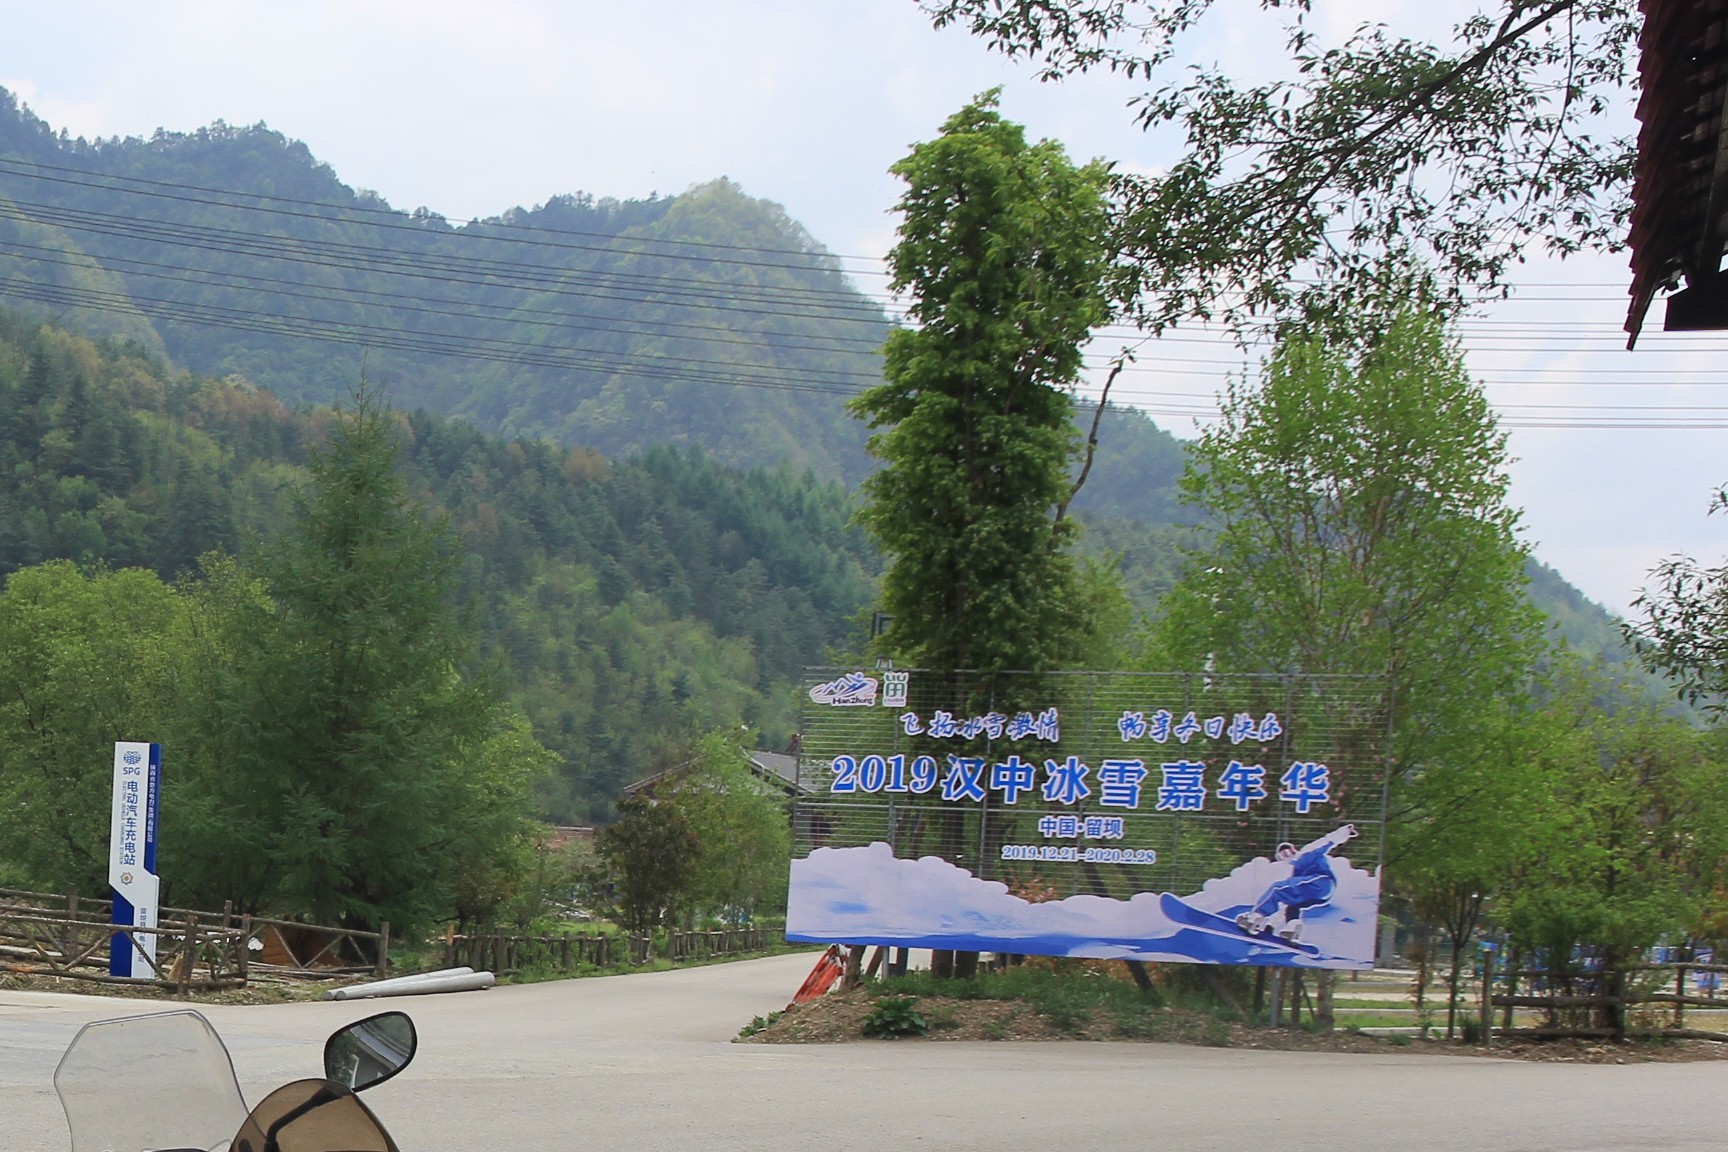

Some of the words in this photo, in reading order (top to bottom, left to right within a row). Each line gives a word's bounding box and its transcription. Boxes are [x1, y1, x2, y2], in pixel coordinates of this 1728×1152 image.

[1118, 709, 1282, 744] 畅享冬日快乐
[122, 767, 141, 776] SPG
[831, 753, 1330, 814] 2019汉中冰雪嘉年华
[123, 780, 139, 866] 电动汽车充电站
